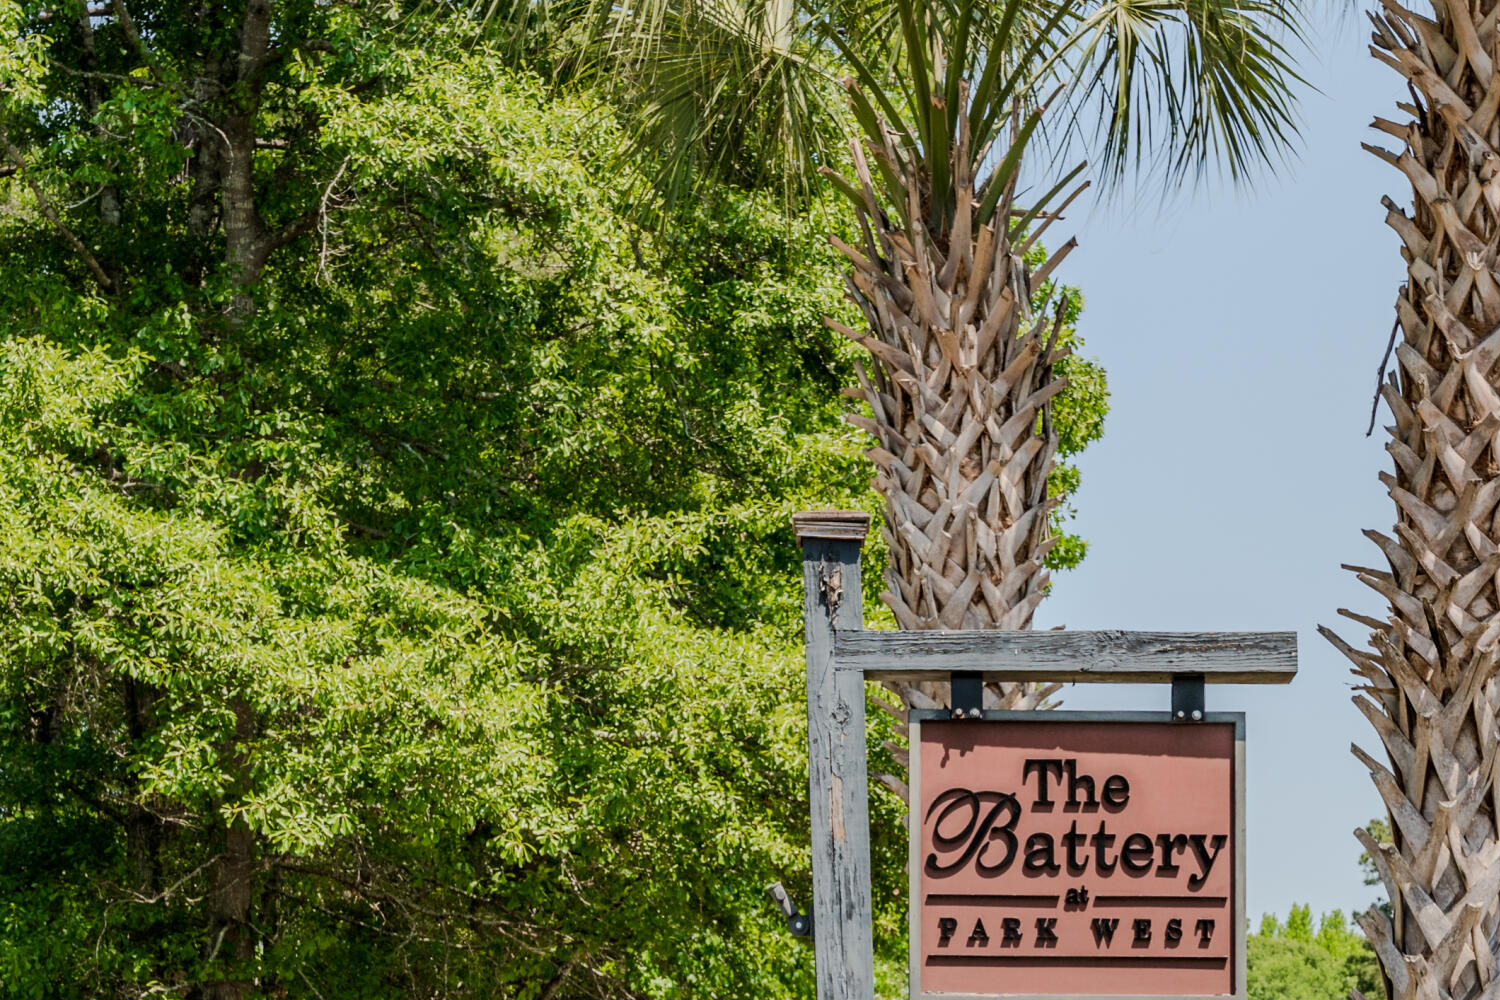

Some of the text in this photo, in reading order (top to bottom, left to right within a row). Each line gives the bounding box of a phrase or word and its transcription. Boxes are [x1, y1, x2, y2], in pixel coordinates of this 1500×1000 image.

[1022, 758, 1130, 812] The
[924, 787, 1228, 890] Battery
[1064, 885, 1089, 909] at
[938, 917, 1216, 947] PARK WEST
